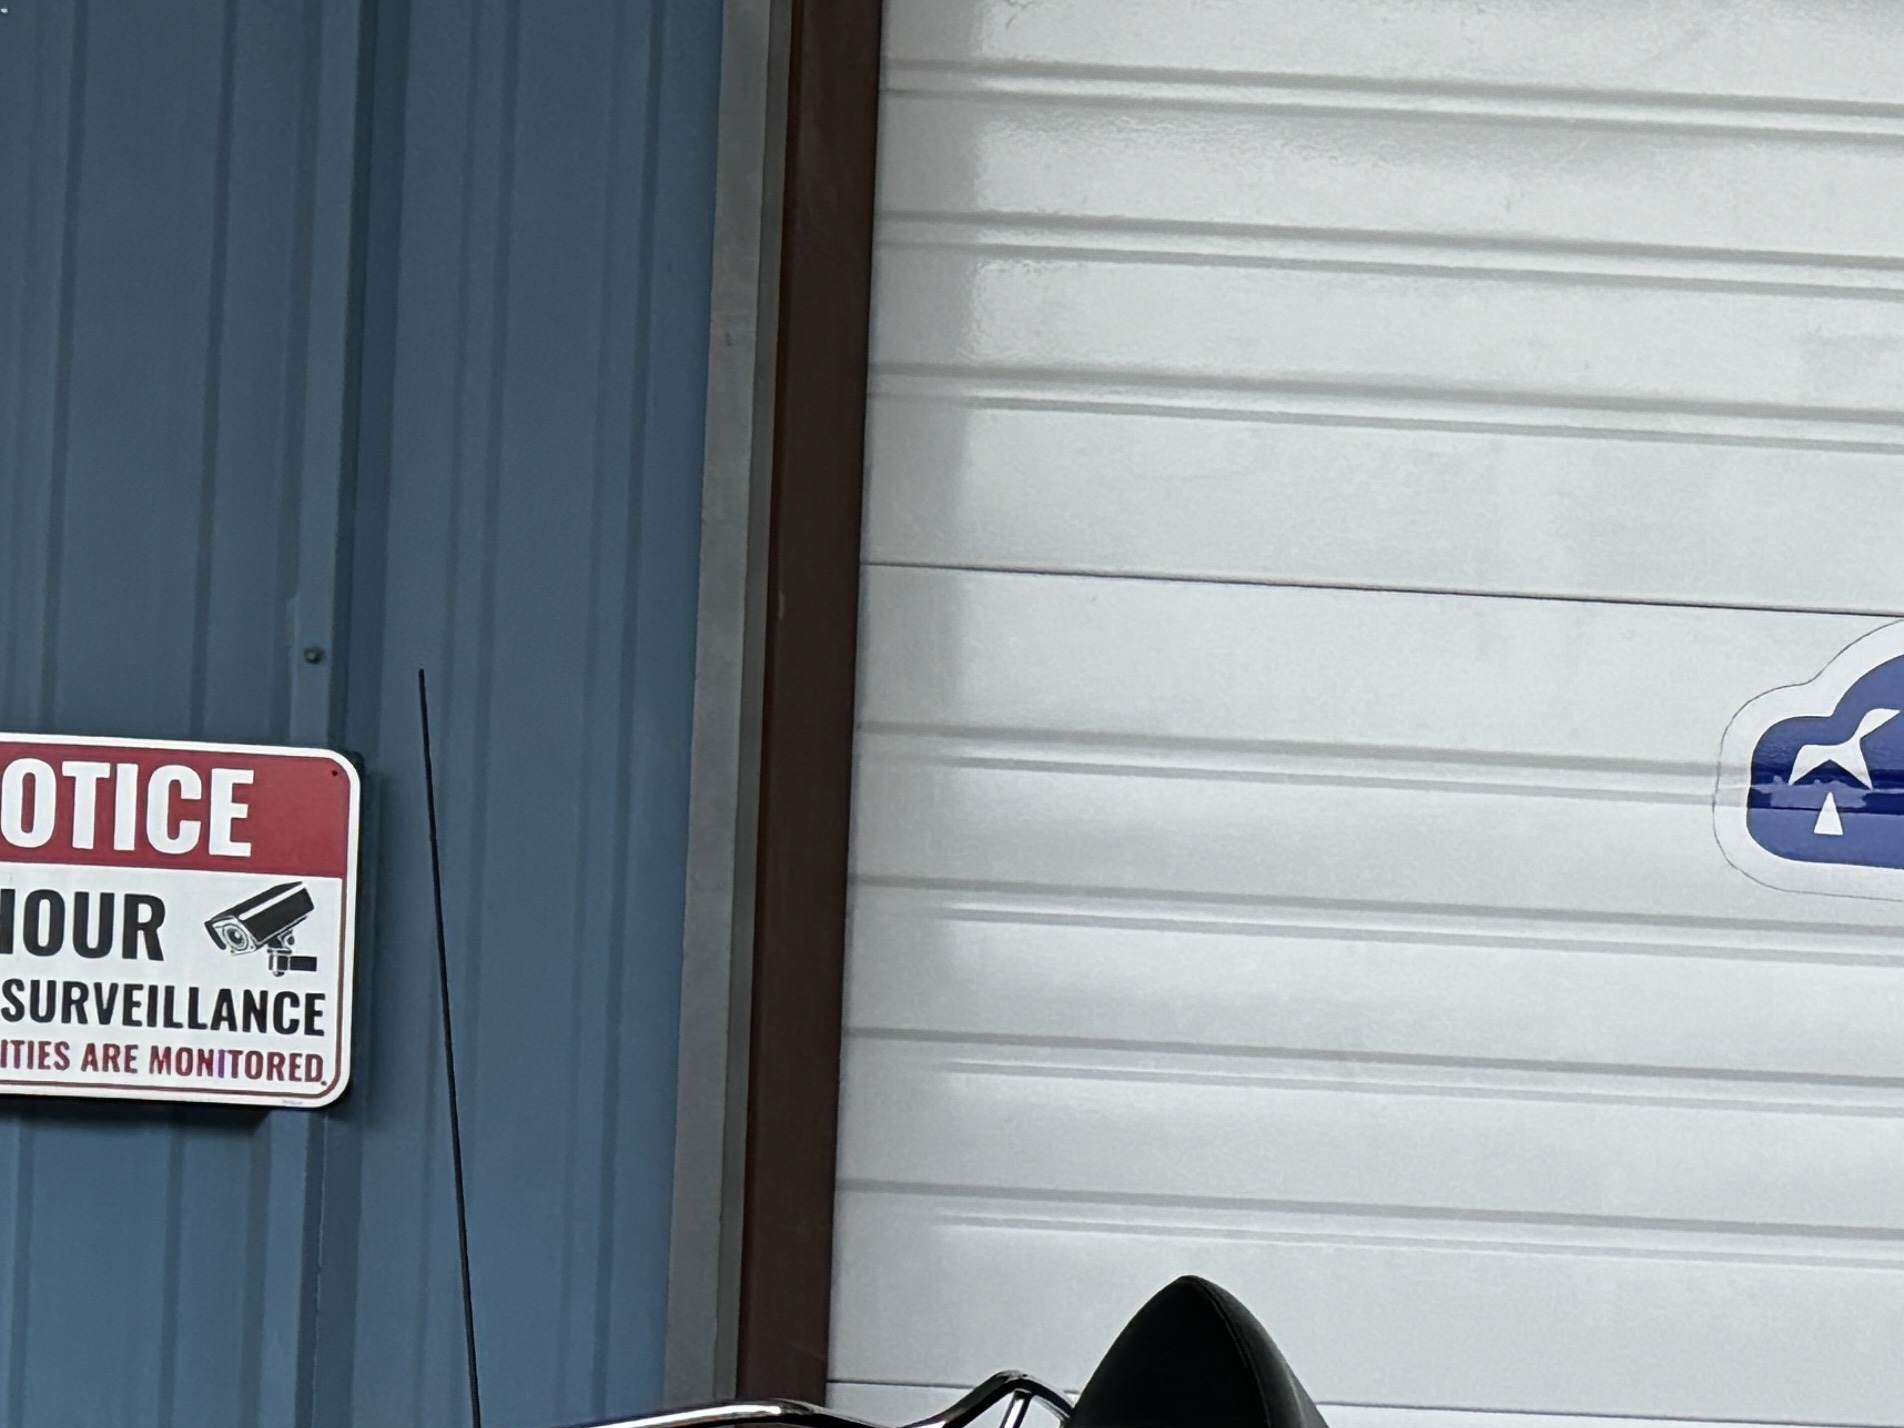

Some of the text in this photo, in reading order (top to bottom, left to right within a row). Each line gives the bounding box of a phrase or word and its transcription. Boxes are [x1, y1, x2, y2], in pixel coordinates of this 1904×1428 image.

[0, 758, 254, 857] OTICE
[1, 978, 326, 1036] SURVEILLANCE
[0, 1039, 70, 1071] ITIES
[81, 1043, 138, 1074] ARE
